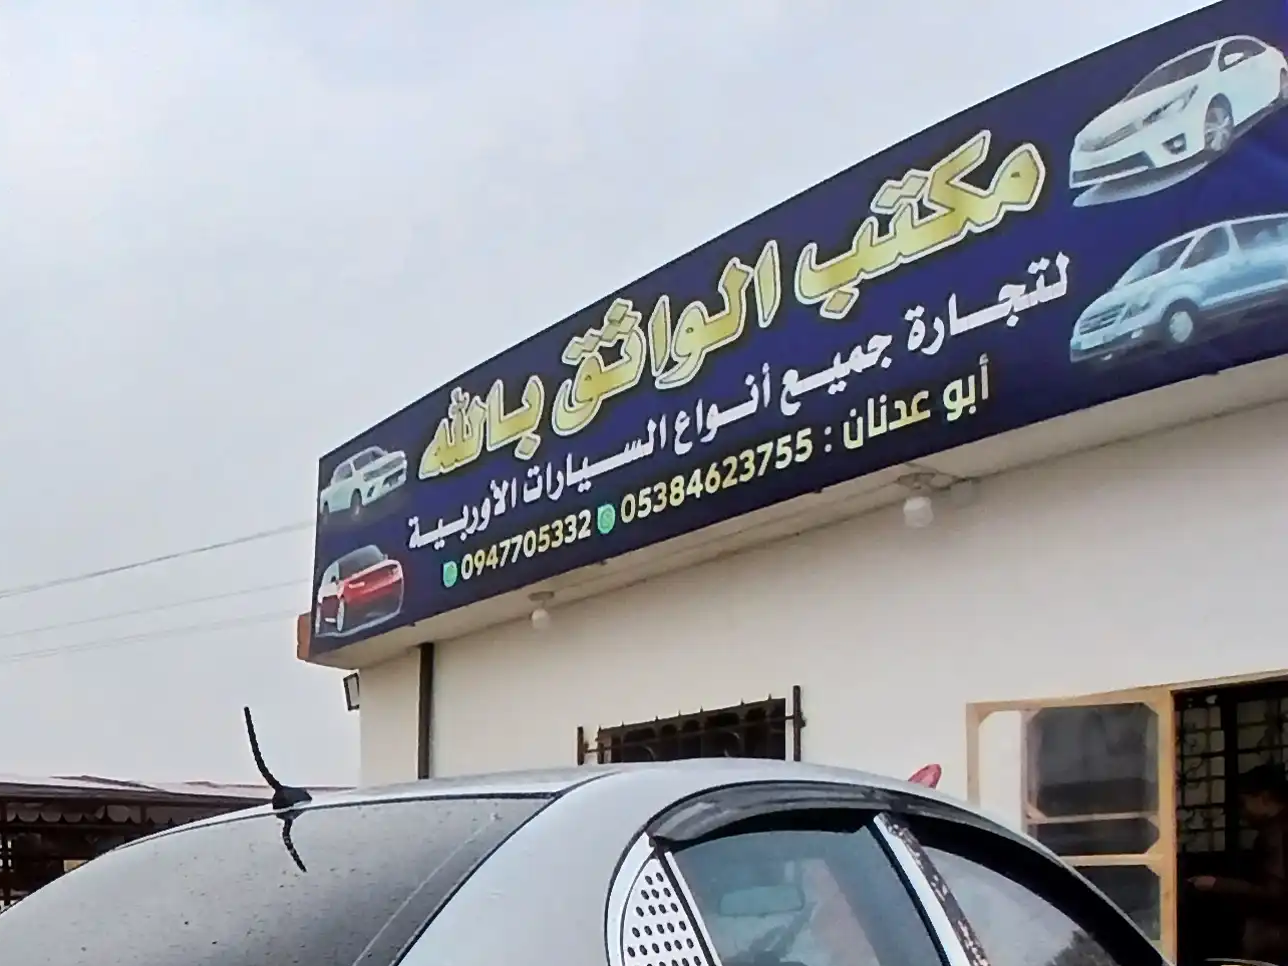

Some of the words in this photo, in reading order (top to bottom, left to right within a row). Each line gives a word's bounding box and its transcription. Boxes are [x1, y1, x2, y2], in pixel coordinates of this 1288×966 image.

[795, 130, 1045, 319] مكتب
[551, 238, 781, 436] الواثق
[904, 252, 1070, 355] لتجارة
[674, 363, 771, 455] أنواع
[780, 333, 893, 415] جميع
[842, 387, 931, 450] عدنان
[942, 353, 990, 422] أبو
[418, 375, 545, 480] بالله
[523, 414, 667, 502] السيارات
[408, 477, 516, 550] الأوربية
[620, 428, 813, 524] 05384623755
[461, 509, 592, 580] 0947705332
